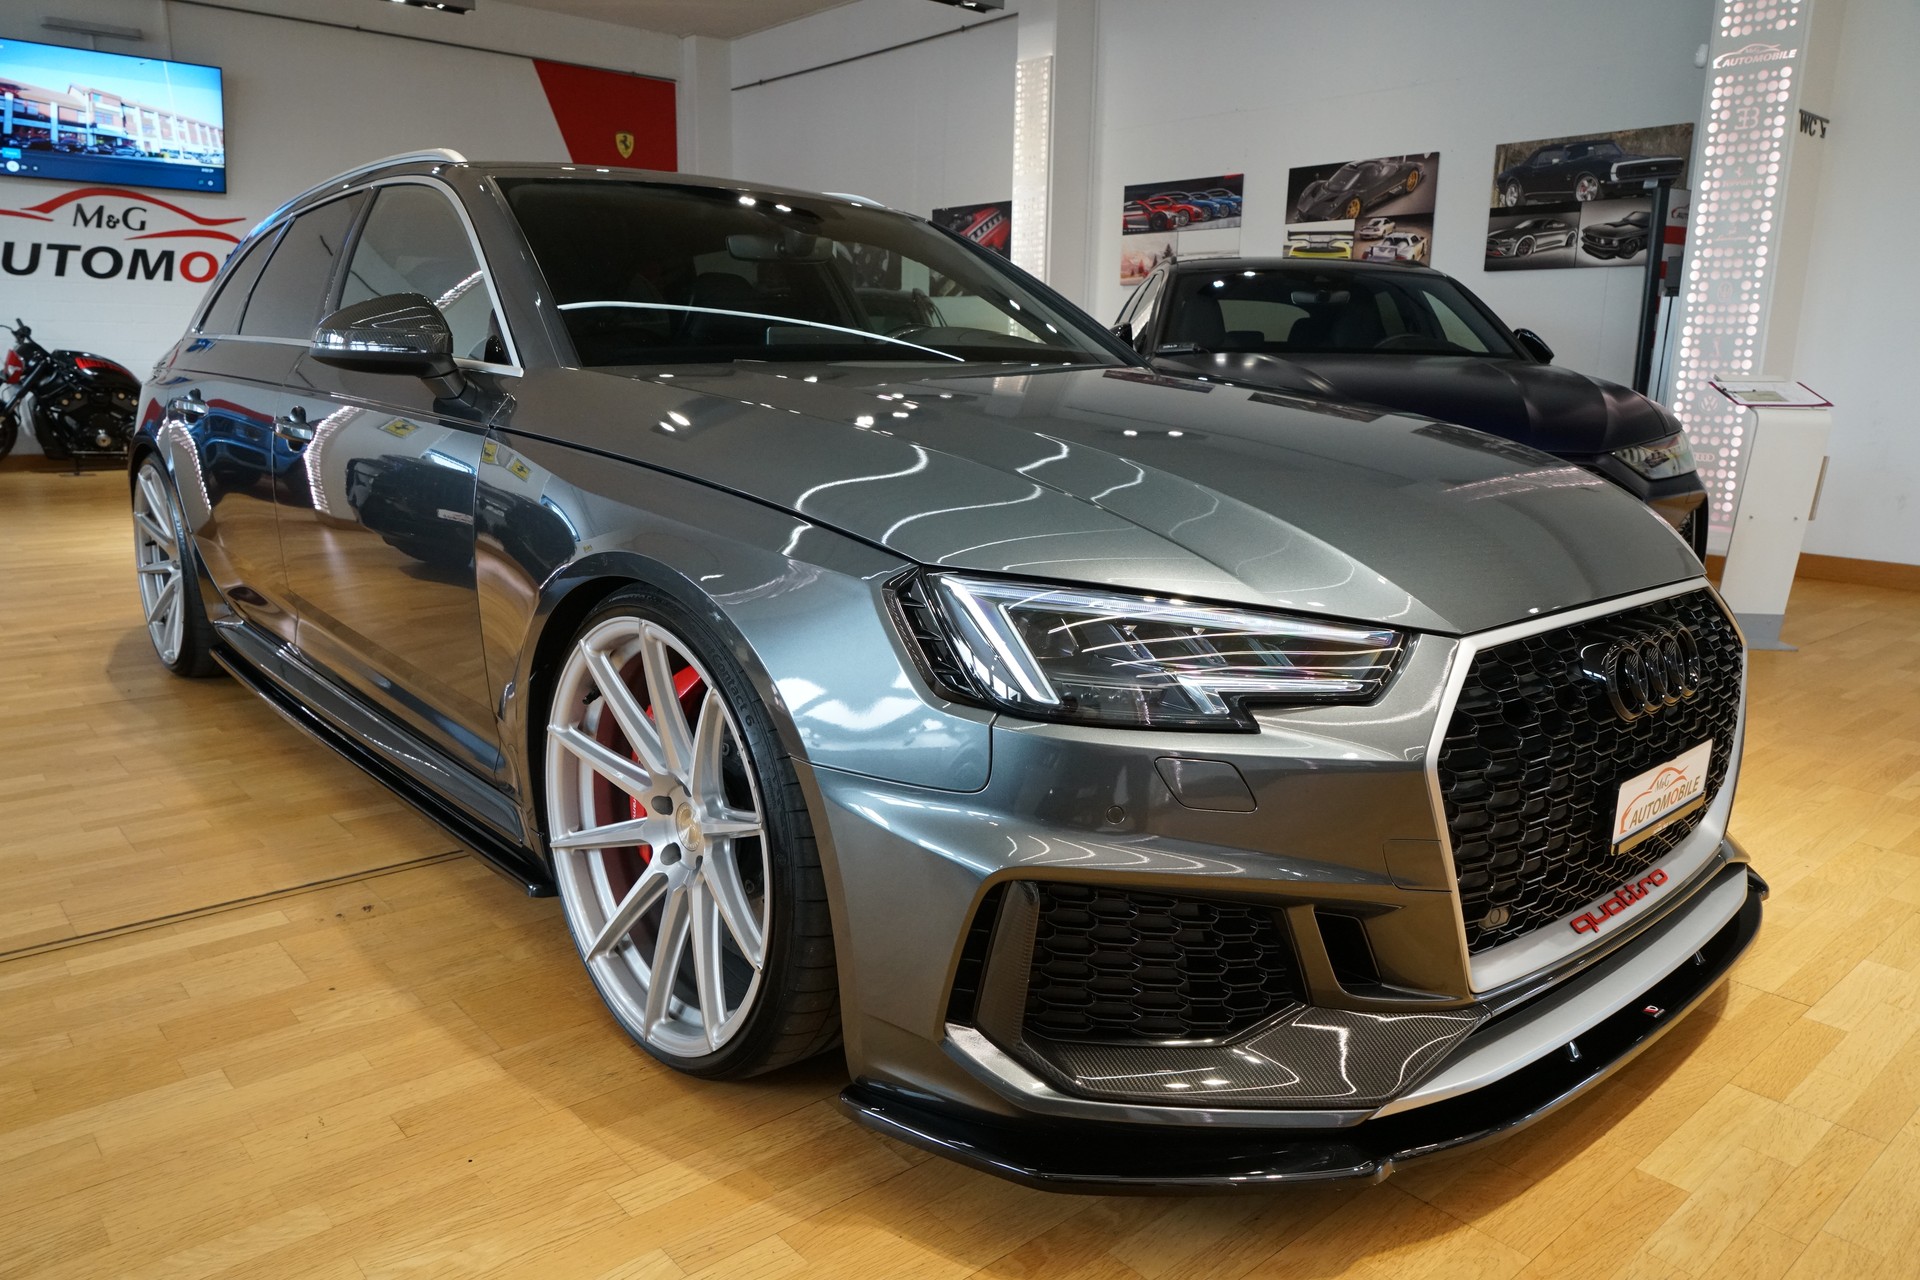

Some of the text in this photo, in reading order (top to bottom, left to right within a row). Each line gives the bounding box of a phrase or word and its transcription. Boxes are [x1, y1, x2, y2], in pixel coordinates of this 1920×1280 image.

[1722, 49, 1797, 67] AUTOMOBILE
[1800, 112, 1817, 136] WC
[73, 203, 147, 231] M&G
[2, 241, 231, 283] UTOMO
[745, 714, 755, 727] 6
[1629, 776, 1701, 829] AUTOMOBILE
[1570, 868, 1668, 934] quattro
